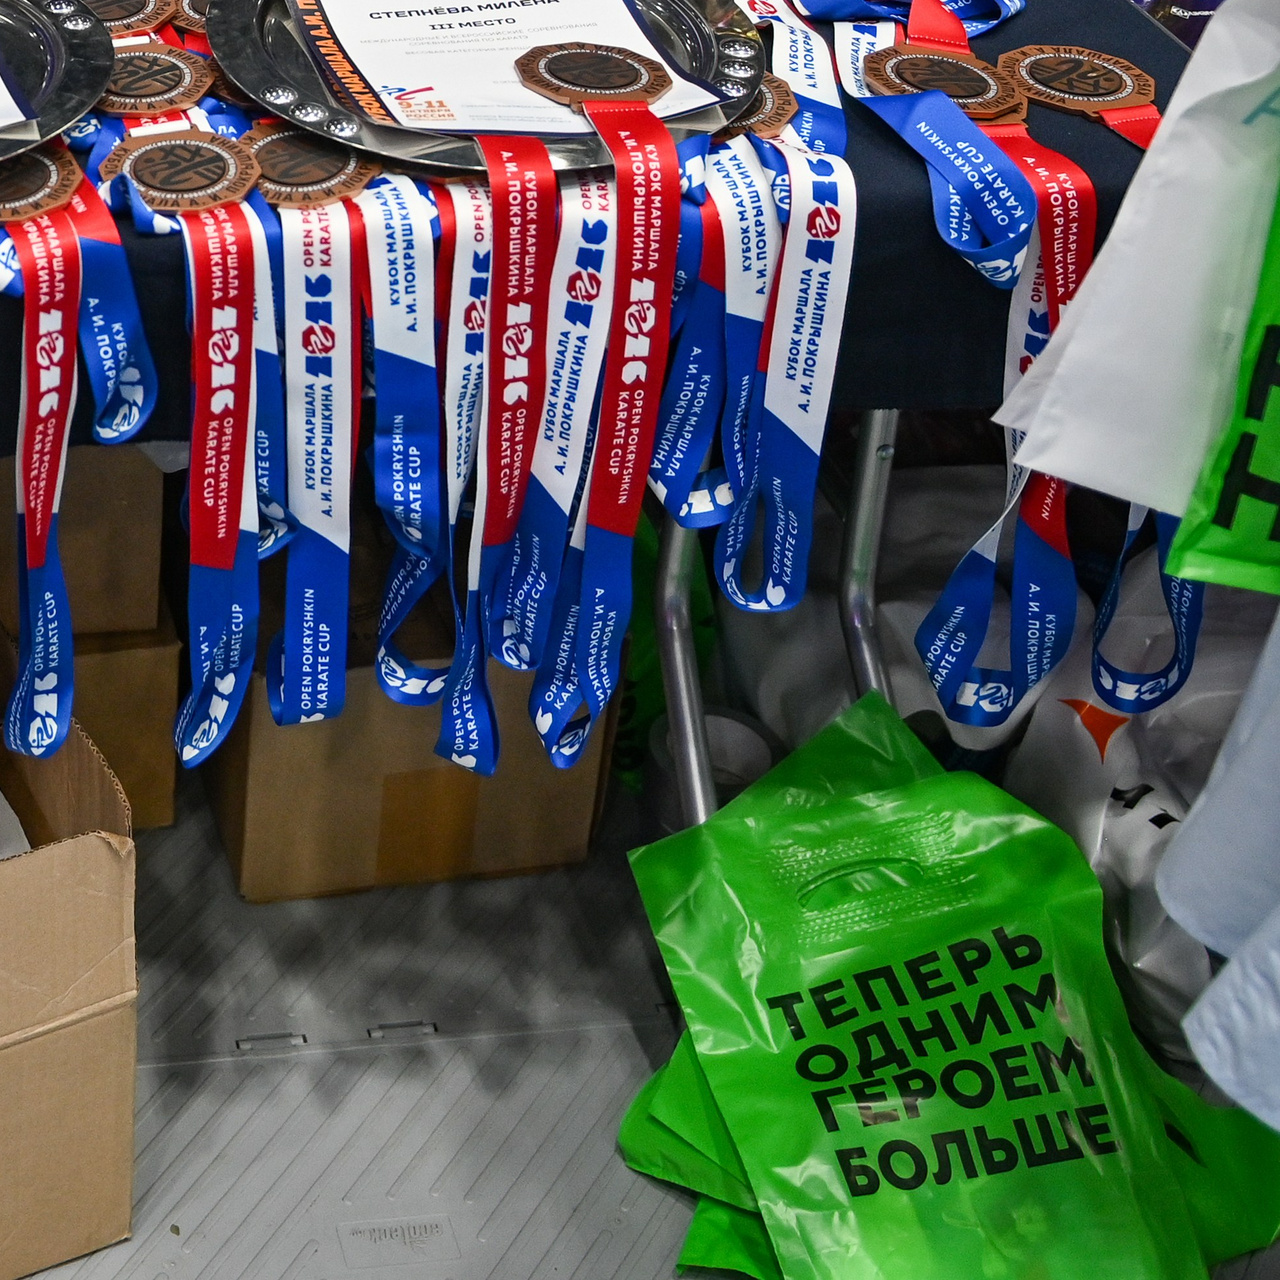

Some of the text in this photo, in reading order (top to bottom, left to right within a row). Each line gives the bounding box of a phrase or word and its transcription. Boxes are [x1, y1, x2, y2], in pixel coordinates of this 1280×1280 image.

[369, 6, 474, 20] СТЕПНЁВА
[459, 17, 516, 29] МЕСТО
[787, 40, 798, 73] КУБОК
[315, 39, 369, 98] МАРШАЛА
[303, 238, 314, 268] OPEN
[375, 190, 401, 306] КУБОК МАРШАЛА
[391, 185, 417, 294] ПОКРЫШКИНА
[506, 179, 521, 298] ПОКРЫШКИНА
[630, 153, 645, 272] ПОКРЫШКИНА
[1046, 183, 1065, 298] ПОКРЫШКИНА
[1056, 172, 1080, 293] КУБОК МАРШАЛА
[220, 221, 239, 299] МАРШАЛА
[805, 271, 831, 378] ПОКРЫШКИНА
[305, 383, 317, 447] МАРШАЛА
[559, 333, 588, 437] ПОКРЫШКИНА
[319, 383, 334, 488] ПОКРЫШКИНА
[217, 453, 231, 538] POKRYSHKIN
[300, 588, 315, 711] OPEN POKRYSHKIN
[523, 571, 548, 644] KARATE CUP
[927, 605, 966, 663] POKRYSHKIN
[950, 631, 968, 652] CUP
[1044, 613, 1056, 647] КУБОК
[316, 623, 331, 710] KARATE CUP
[545, 680, 556, 704] OPEN
[454, 718, 465, 751] OPEN
[767, 926, 1043, 1042] ТЕПЕРЬ
[794, 973, 1060, 1083] ОДНИМ
[810, 1035, 1096, 1134] ГЕРОЕМ
[837, 1103, 1124, 1199] БОЛЬШЕ
